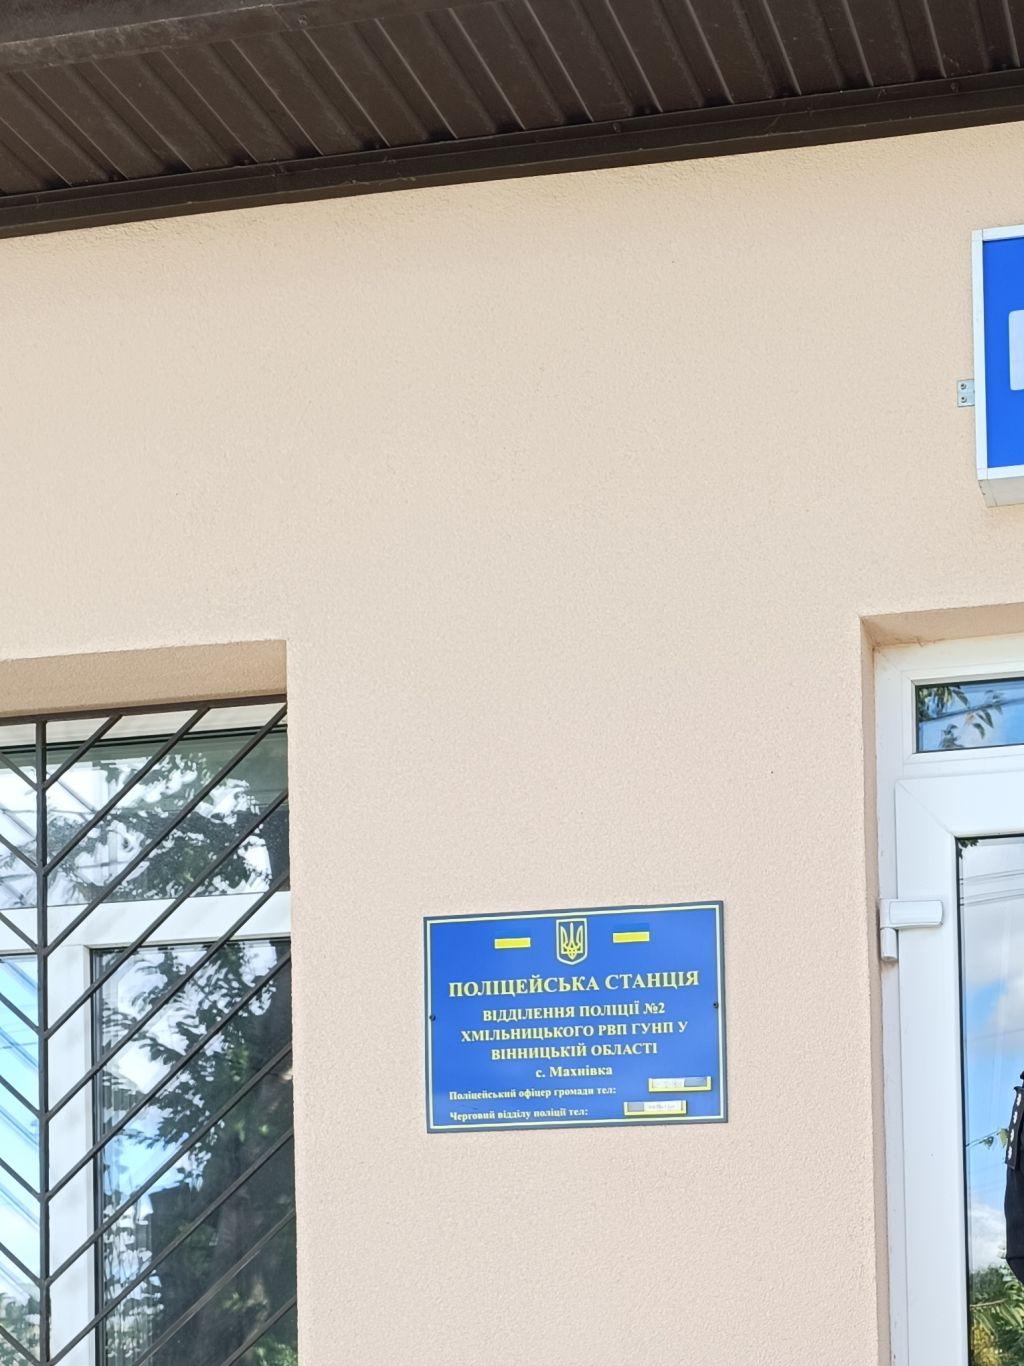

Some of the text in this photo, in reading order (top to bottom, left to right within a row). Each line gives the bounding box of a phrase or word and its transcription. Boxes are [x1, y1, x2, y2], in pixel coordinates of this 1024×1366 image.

[449, 970, 700, 997] ПОЛІЦЕЙСЬКА СТАНЦІЯ
[483, 1000, 666, 1023] ВІДДІЛЕННЯ ПОЛІЦІЇ №2
[460, 1020, 689, 1042] ХМІЛЬНИЦЬКОГО РВП ГУНП У
[491, 1042, 658, 1060] ВІННИЦЬКІЙ ОБЛАСТІ
[535, 1065, 613, 1078] с. Махнівка
[449, 1086, 617, 1100] Поліцейський офіцер громади тел:
[449, 1107, 588, 1122] Черговий відділу поліції тел:
